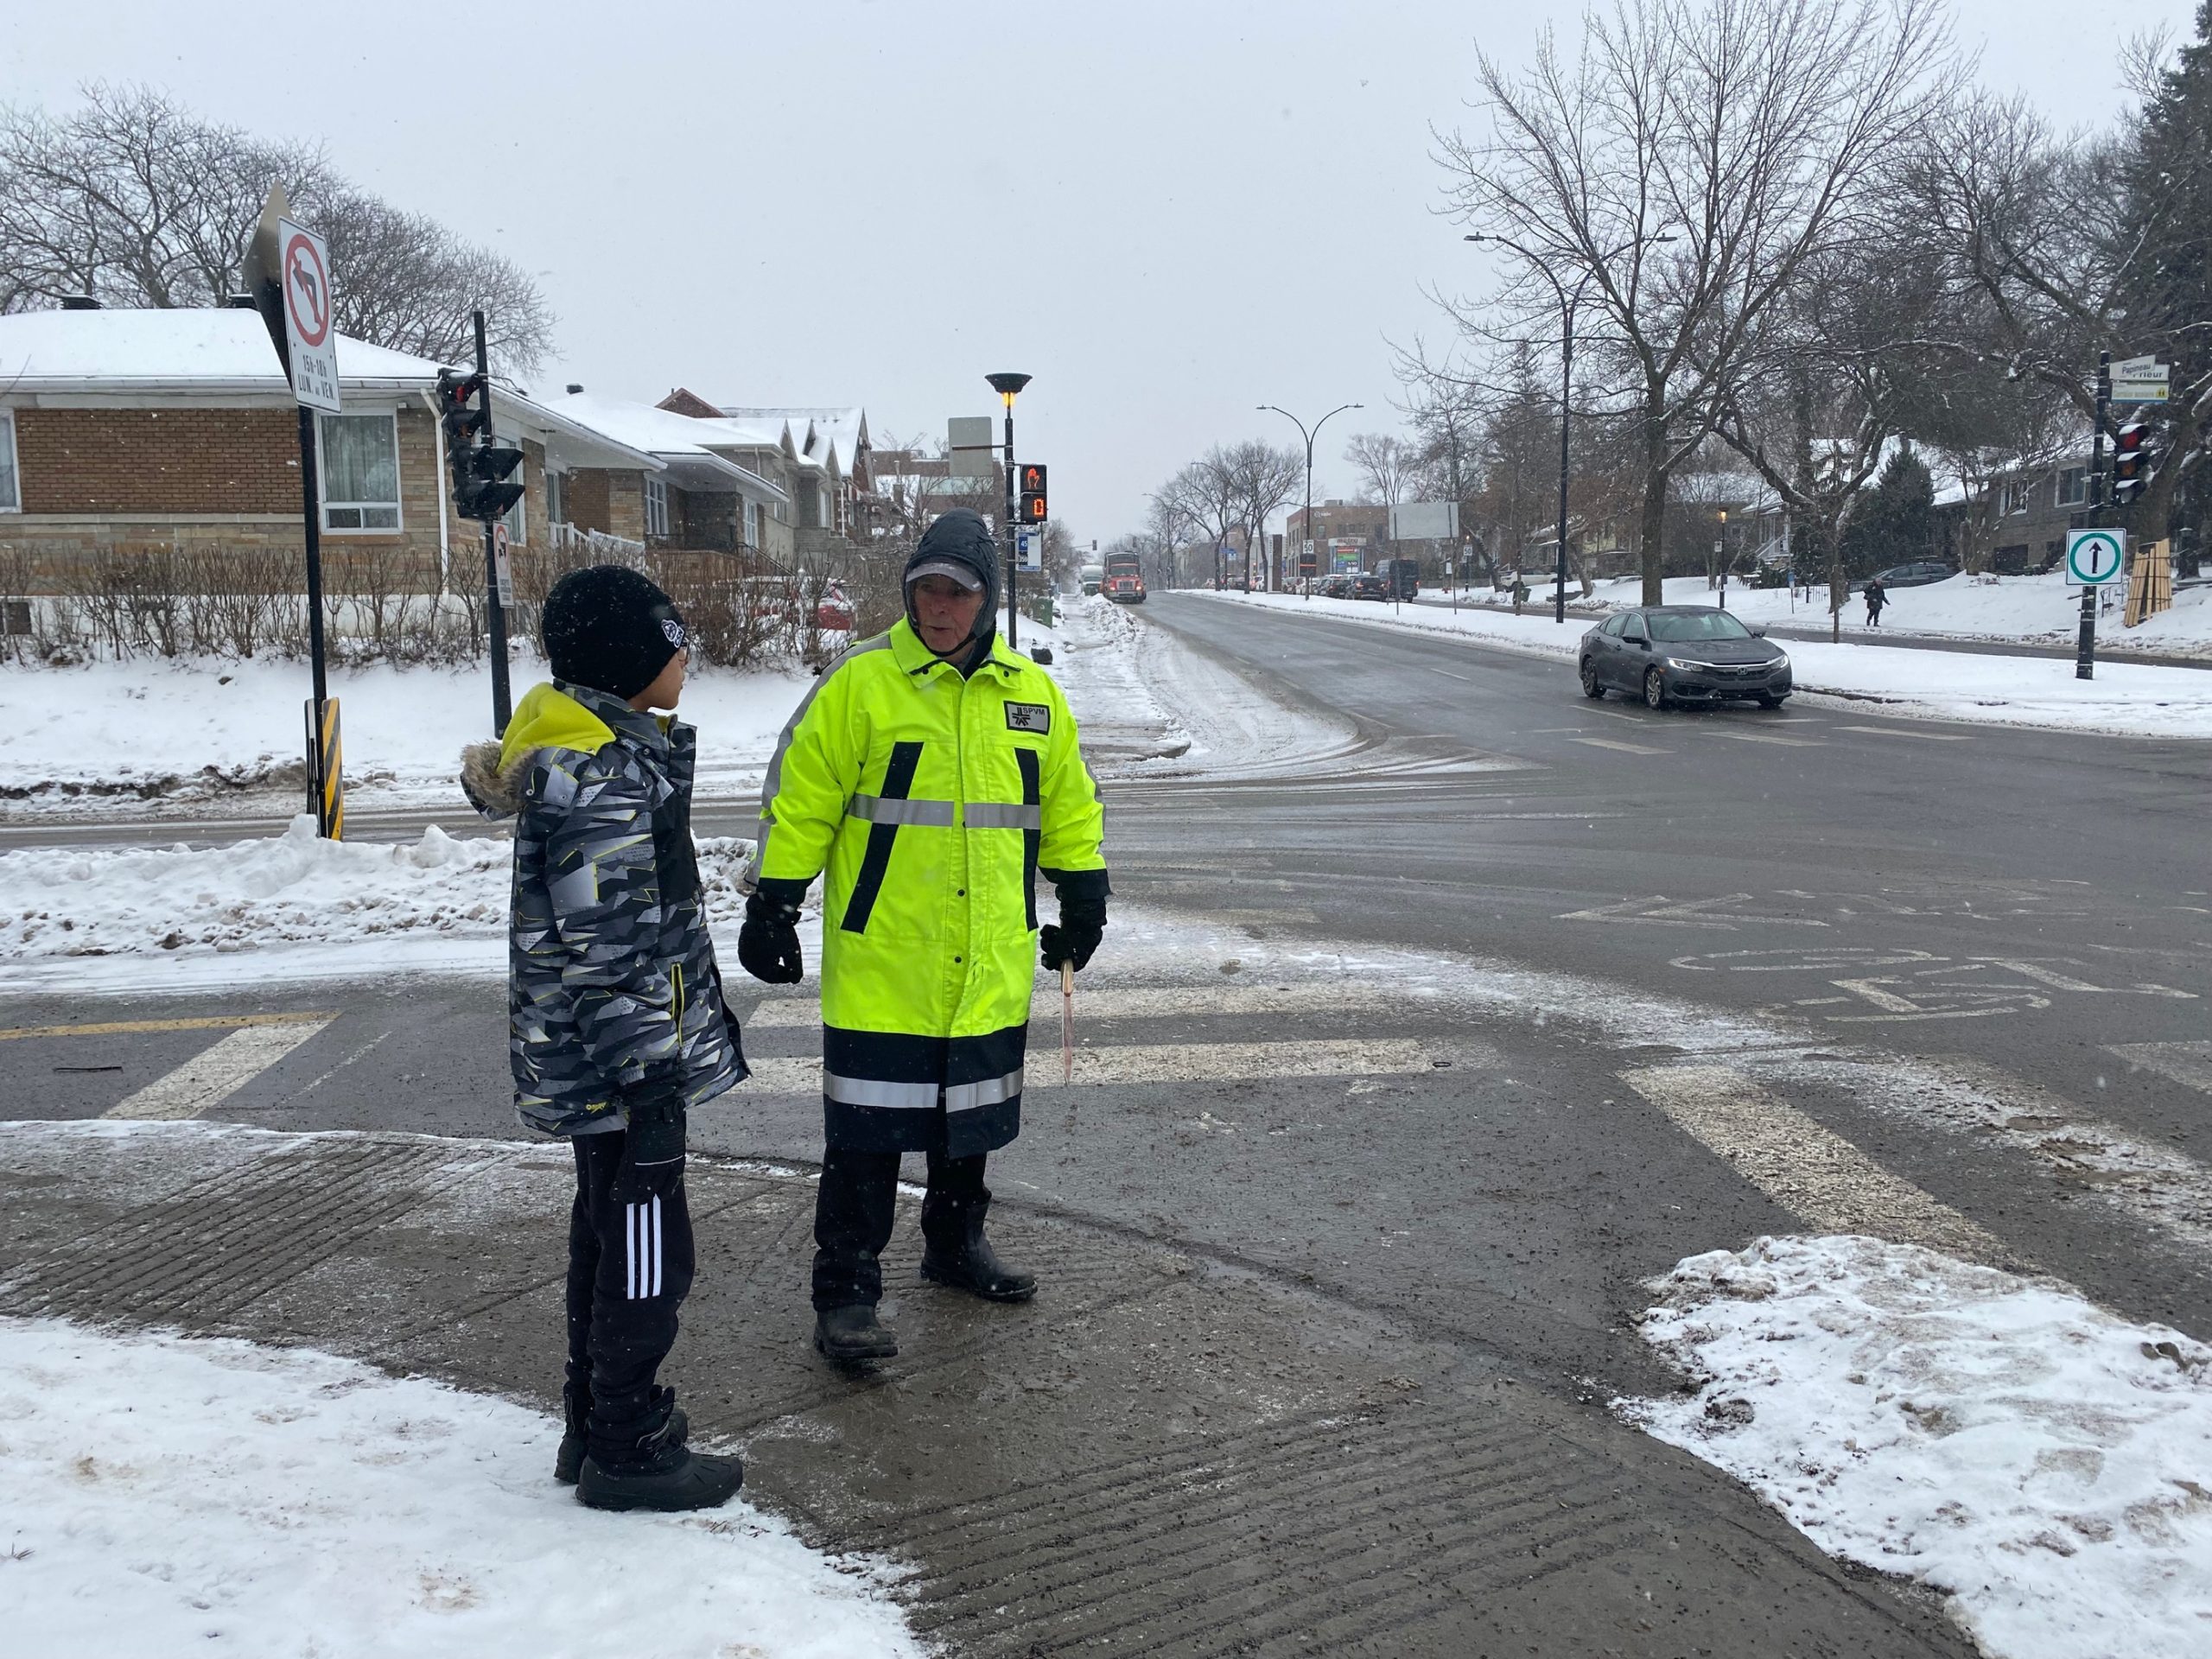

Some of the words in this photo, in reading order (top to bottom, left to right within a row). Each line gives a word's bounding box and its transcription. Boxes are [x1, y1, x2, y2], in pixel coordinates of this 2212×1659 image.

[302, 354, 327, 378] 15h-18h
[2121, 363, 2152, 375] Papineau
[1303, 543, 1313, 552] 50
[1022, 707, 1046, 716] SPVM
